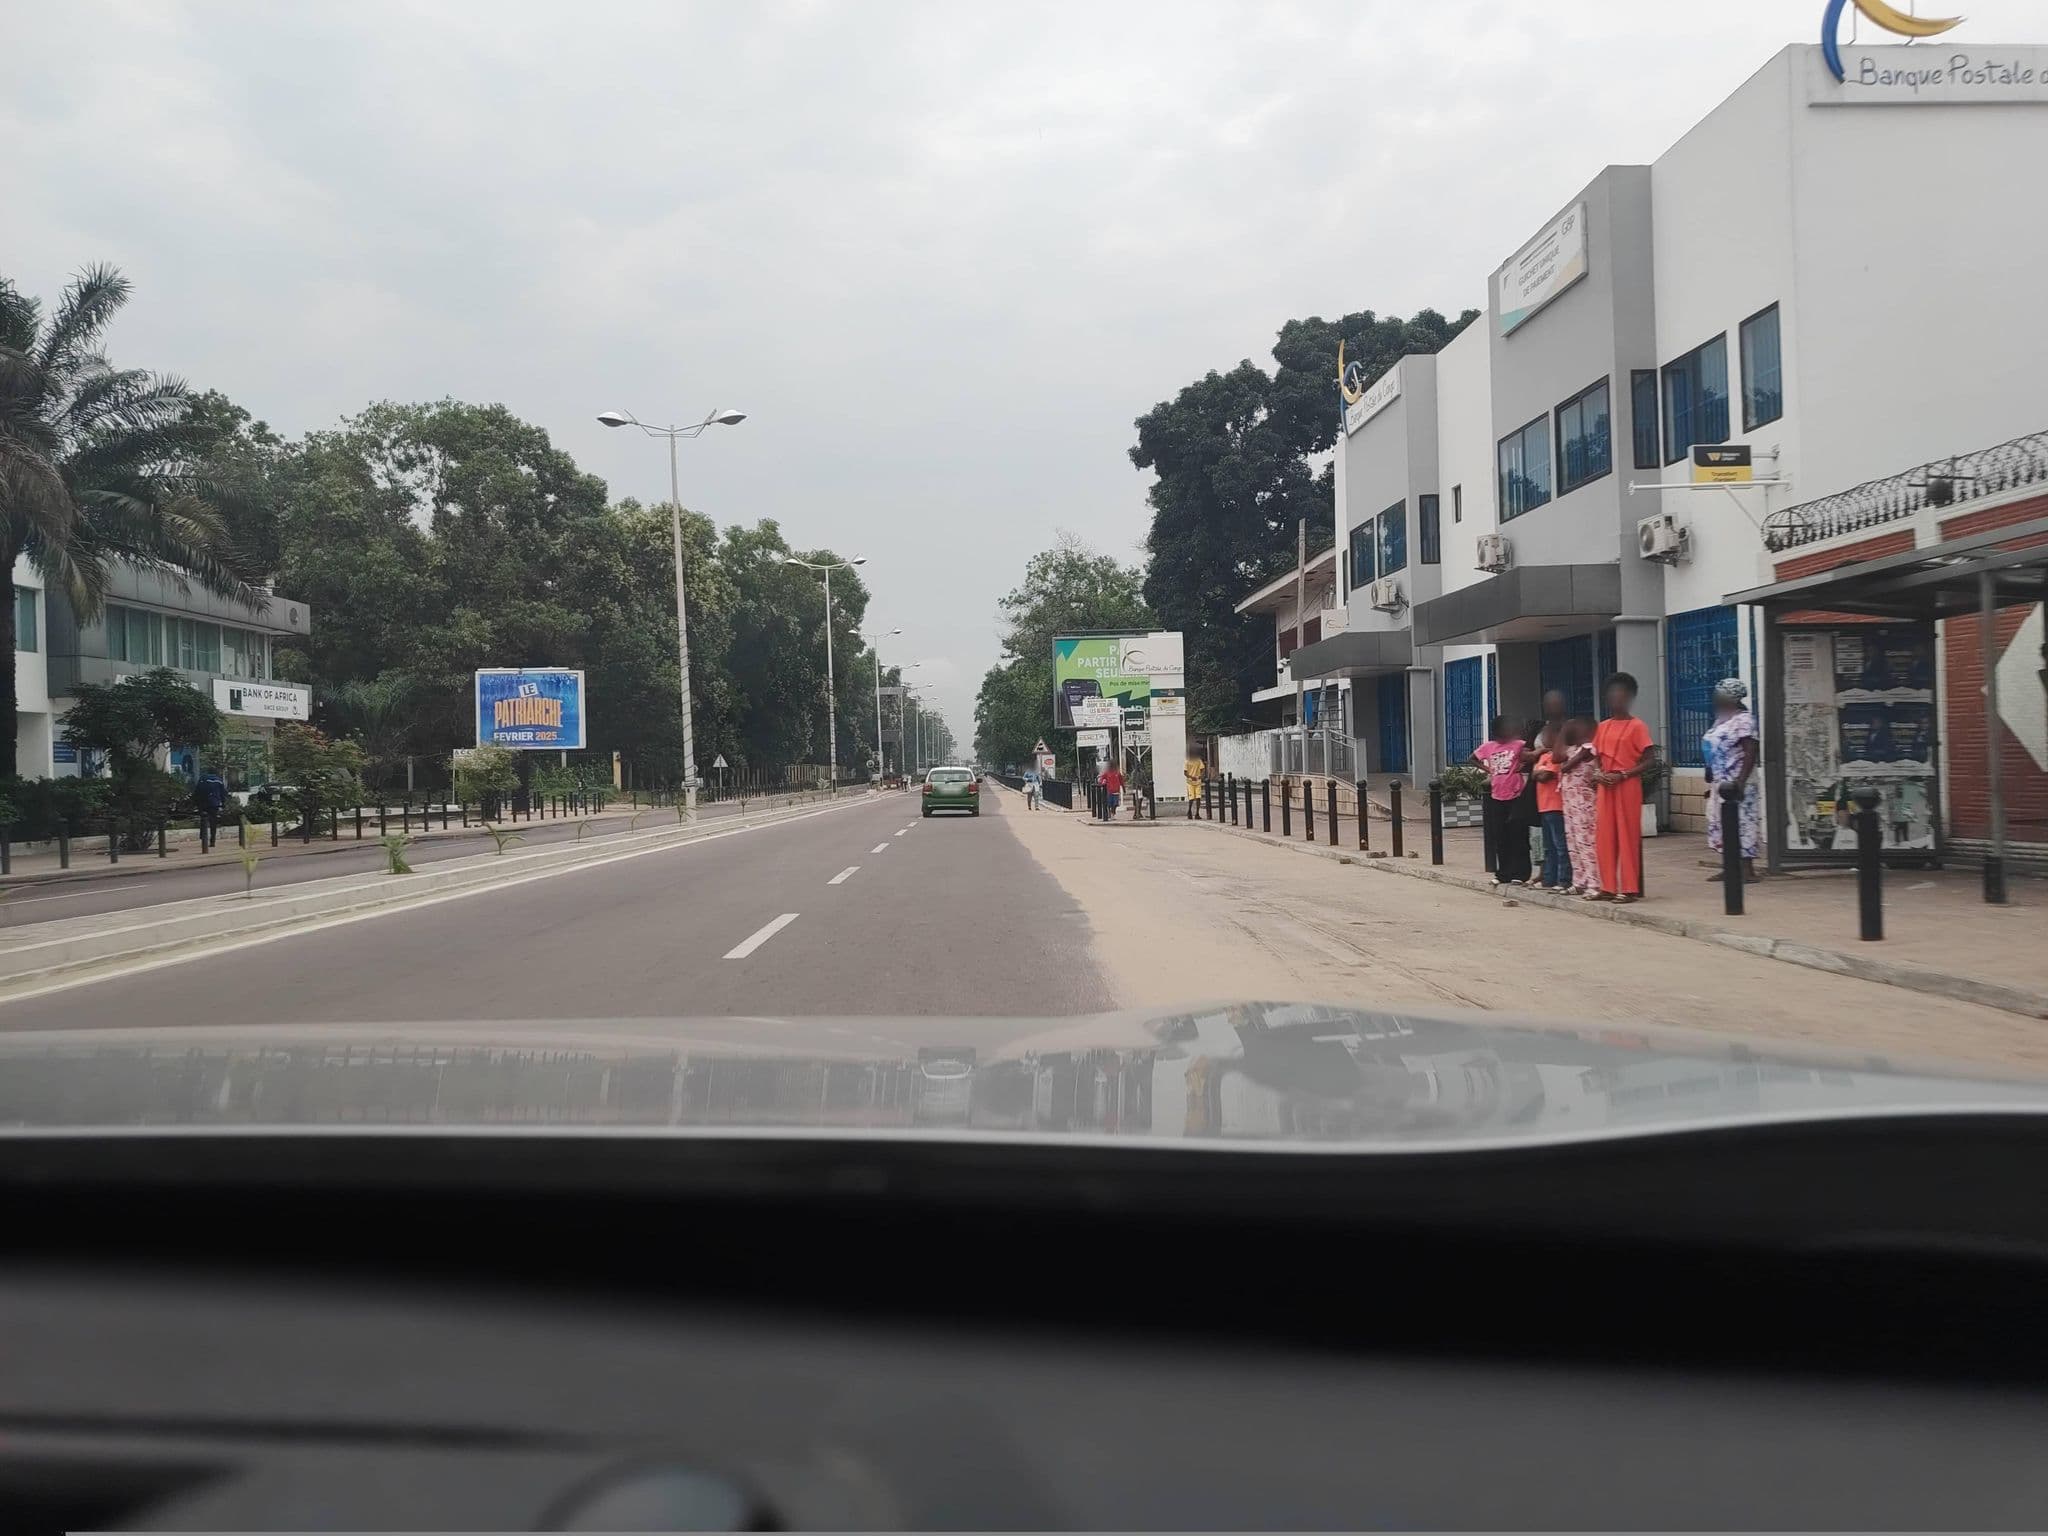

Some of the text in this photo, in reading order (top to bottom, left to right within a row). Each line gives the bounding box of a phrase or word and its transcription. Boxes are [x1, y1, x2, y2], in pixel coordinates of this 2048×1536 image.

[1849, 57, 1942, 93] Banque
[1948, 54, 2034, 85] Postale
[1077, 657, 1117, 668] PARTIR
[243, 688, 298, 702] BANK OF AFRICA
[523, 685, 536, 695] LE
[495, 697, 563, 729] PATRIARCHE
[494, 731, 558, 741] FEVRIER 2025
